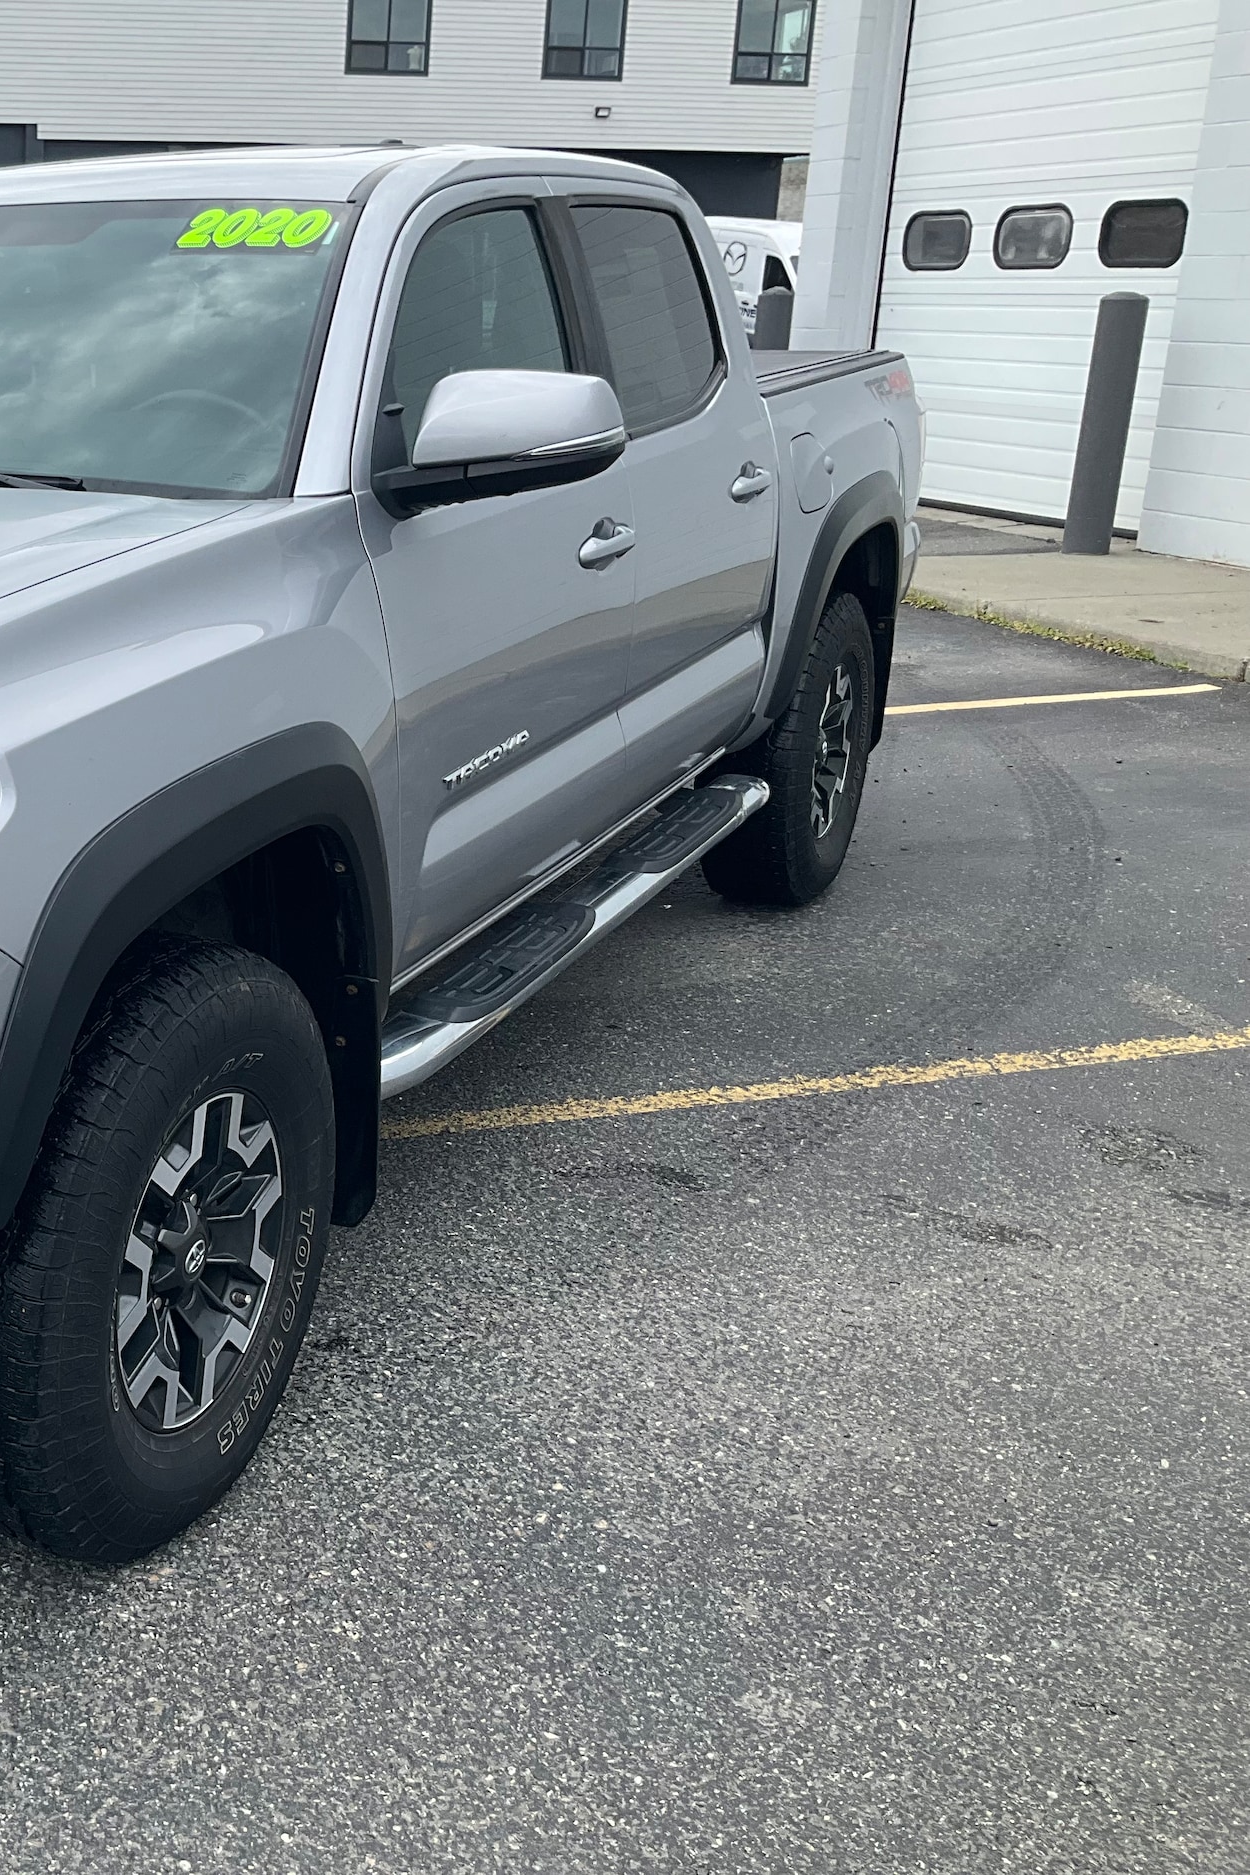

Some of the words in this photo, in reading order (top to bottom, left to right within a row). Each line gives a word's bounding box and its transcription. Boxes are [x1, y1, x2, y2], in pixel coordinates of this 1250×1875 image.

[176, 208, 333, 248] 2020
[442, 730, 530, 791] TACOMA
[279, 1207, 316, 1333] TOYO
[216, 1337, 284, 1456] TIRES
